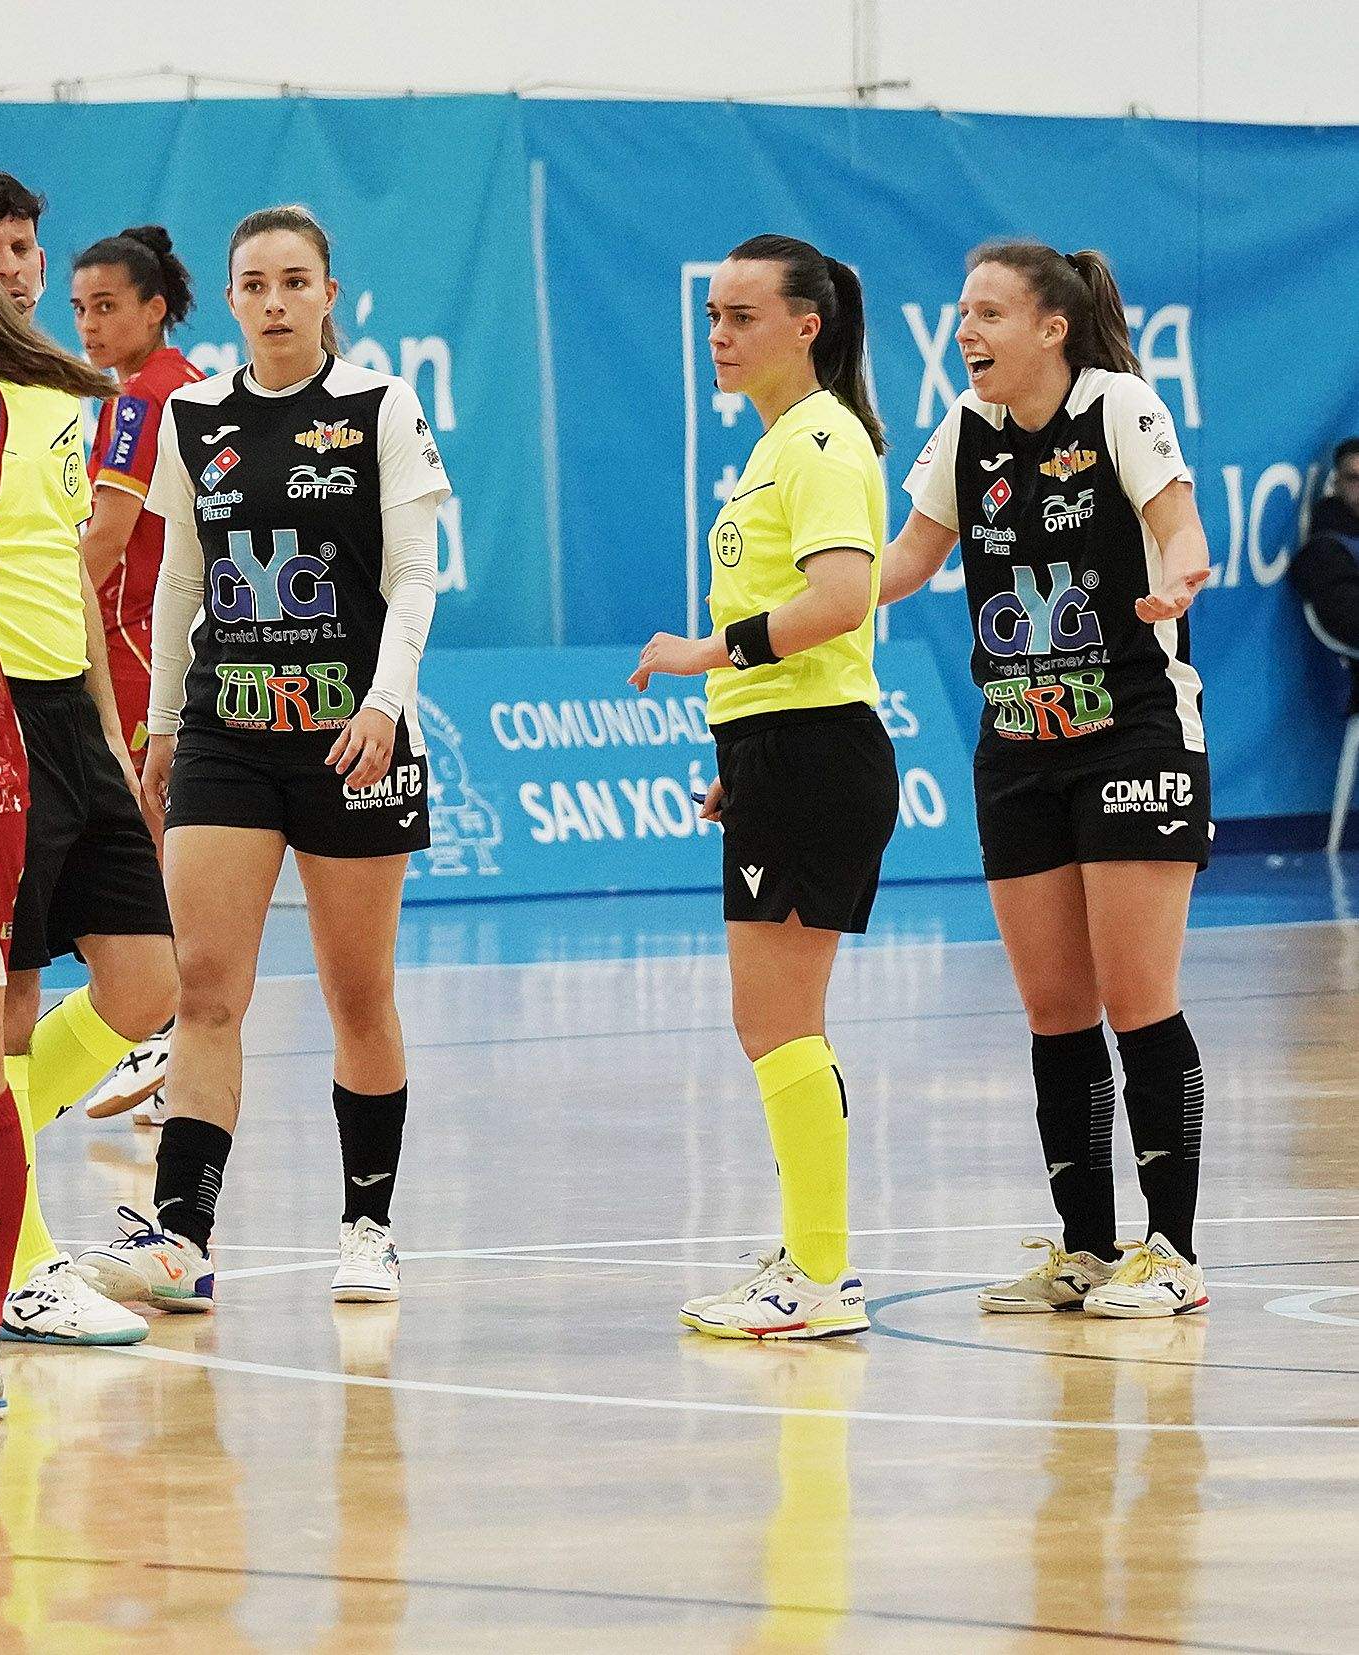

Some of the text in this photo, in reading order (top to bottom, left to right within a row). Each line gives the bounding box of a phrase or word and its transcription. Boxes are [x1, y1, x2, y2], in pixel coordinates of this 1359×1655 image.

[196, 490, 243, 509] Domino's
[202, 505, 232, 522] Pizza
[262, 626, 319, 645] Sarpey
[490, 695, 714, 752] COMUNIDAD
[1101, 779, 1154, 803] CDM
[345, 795, 404, 811] GRUPO CDM
[520, 779, 626, 844] SAN
[1103, 801, 1168, 814] GRUPO CDM
